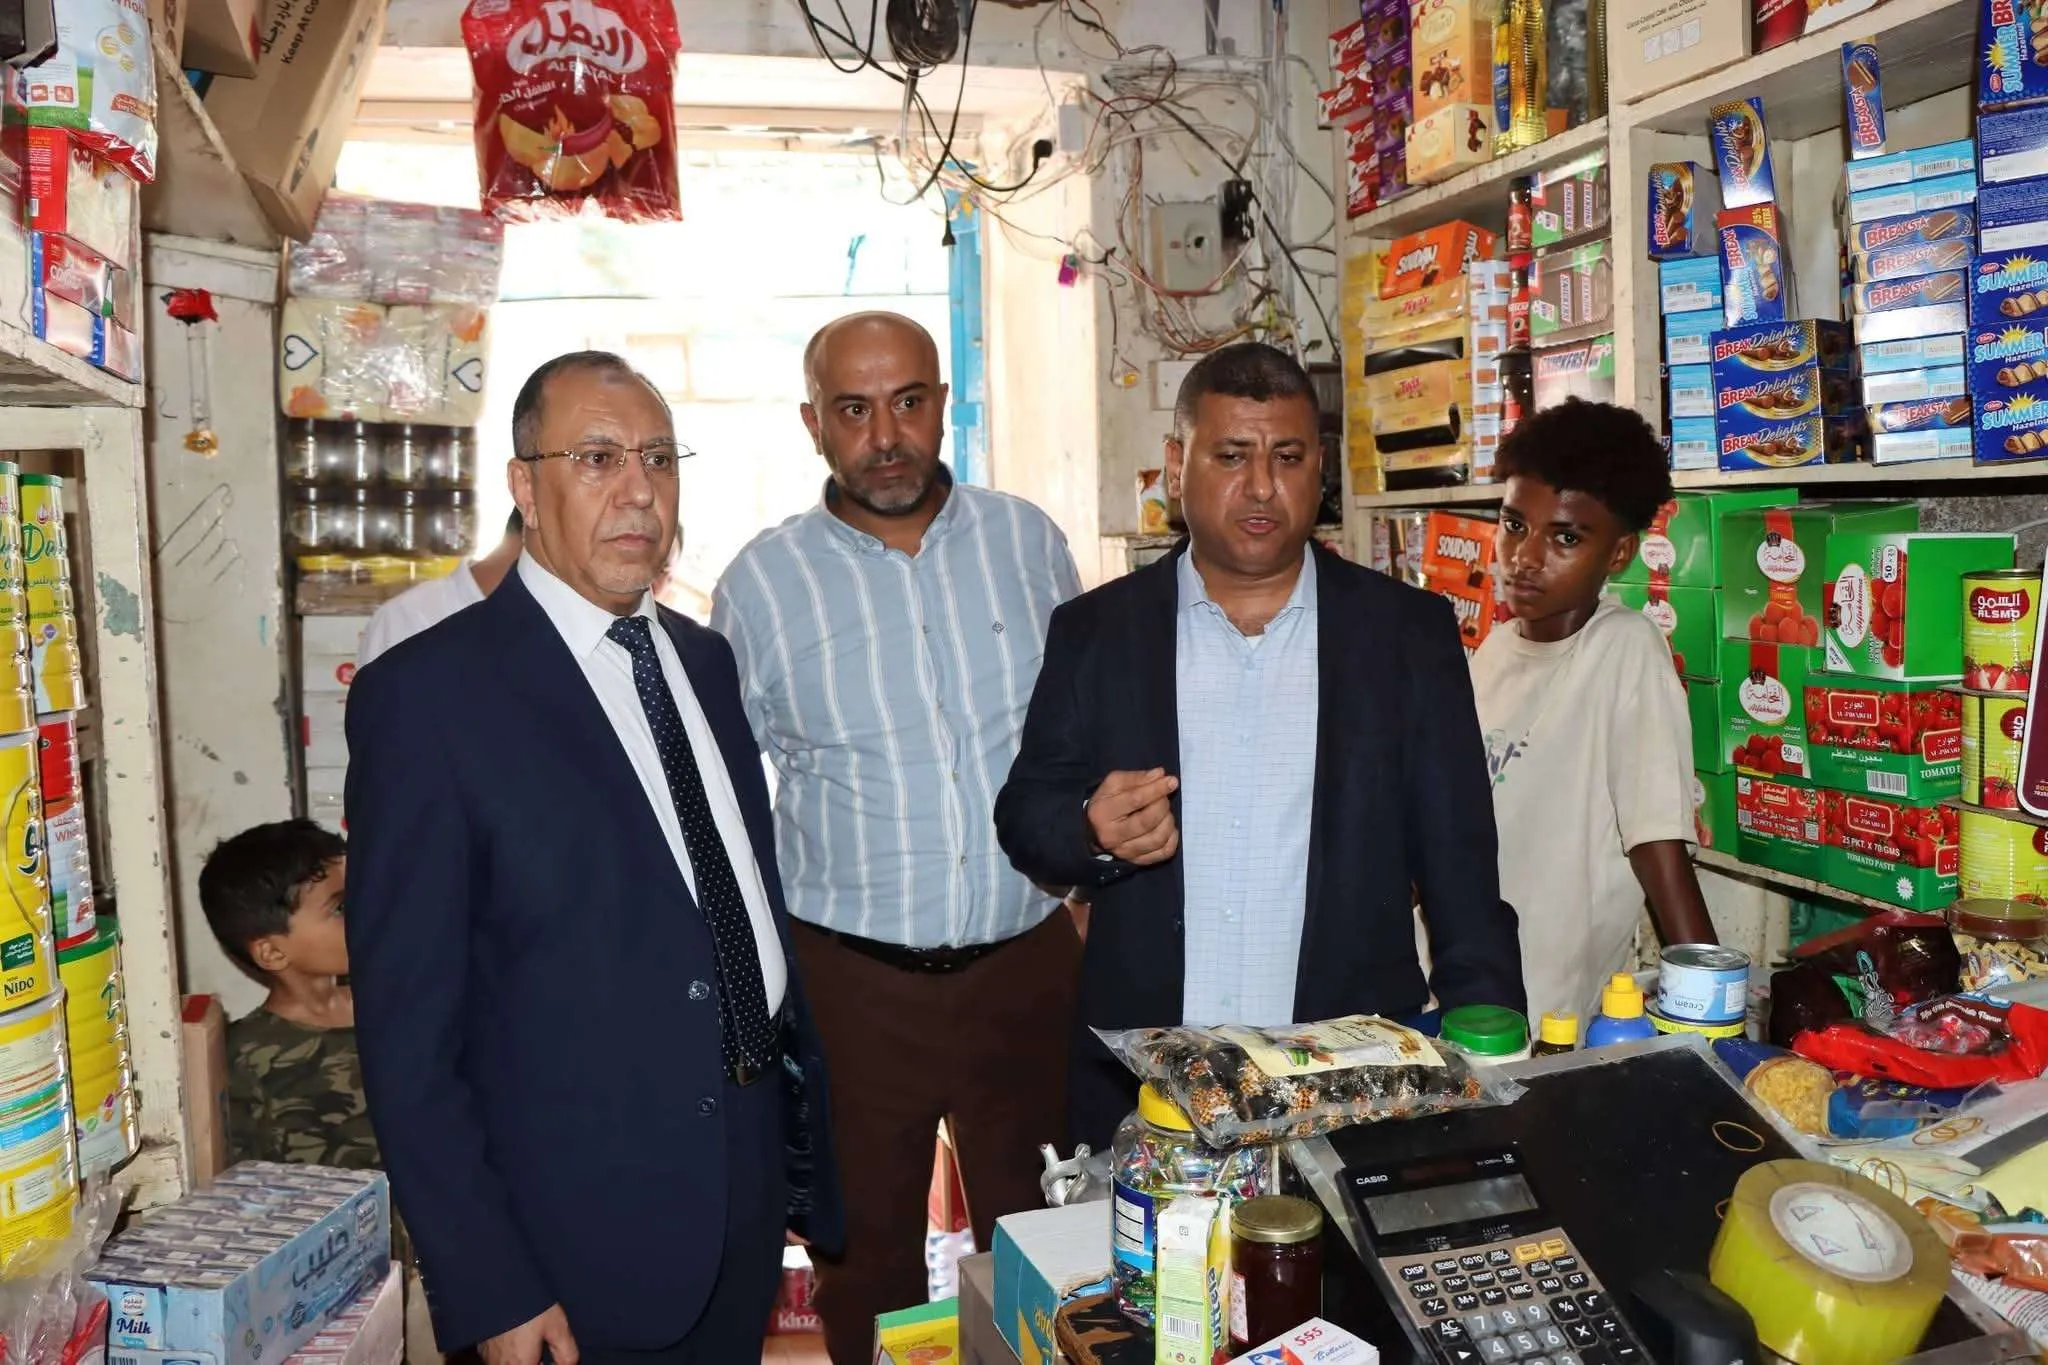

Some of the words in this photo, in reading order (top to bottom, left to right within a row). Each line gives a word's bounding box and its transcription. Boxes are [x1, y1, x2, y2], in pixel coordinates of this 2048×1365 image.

[280, 33, 303, 64] Keep
[2015, 22, 2029, 60] Hazelnut
[1997, 24, 2024, 92] SUMMER
[1849, 86, 1881, 147] BREAKSTA
[1865, 215, 1929, 249] BREAKSTA
[1722, 228, 1746, 270] BREAK
[1873, 245, 1938, 278] BREAKSTA
[1977, 261, 2048, 293] SUMMER
[2009, 279, 2048, 293] Hazelnu
[1868, 279, 1933, 309] BREAKSTA
[1714, 338, 1752, 362] BREAK
[1750, 323, 1800, 348] Delights
[1975, 332, 2043, 363] SUMMER
[2005, 349, 2045, 364] Hazelnut
[1719, 386, 1758, 409] BREAK
[1756, 372, 1804, 396] Delights
[1721, 433, 1760, 456] BREAK
[1759, 421, 1808, 443] Delights
[1884, 564, 1893, 579] 50
[1977, 593, 2020, 610] السمو
[1783, 746, 1792, 757] 50
[1920, 766, 1956, 780] TOMATO
[1846, 852, 1874, 867] TOMATO
[1874, 859, 1896, 872] PASTE
[3, 976, 35, 998] NIDO
[1674, 999, 1704, 1011] Cream
[1356, 1174, 1389, 1186] CASIO
[292, 1229, 350, 1291] حليب
[1404, 1265, 1425, 1275] DISP
[1415, 1284, 1435, 1292] TAX+
[1499, 1268, 1520, 1276] DELETE
[1458, 1295, 1475, 1305] M+
[1510, 1284, 1532, 1294] MRC
[1542, 1279, 1559, 1289] MU
[1570, 1274, 1585, 1284] GT
[116, 1318, 152, 1335] Milk
[1440, 1319, 1457, 1331] AC
[1474, 1315, 1486, 1330] 7
[1501, 1310, 1517, 1325] 8
[1528, 1304, 1541, 1320] 9
[1492, 1340, 1505, 1355] 4
[1518, 1334, 1533, 1350] 5
[1547, 1330, 1560, 1345] 6
